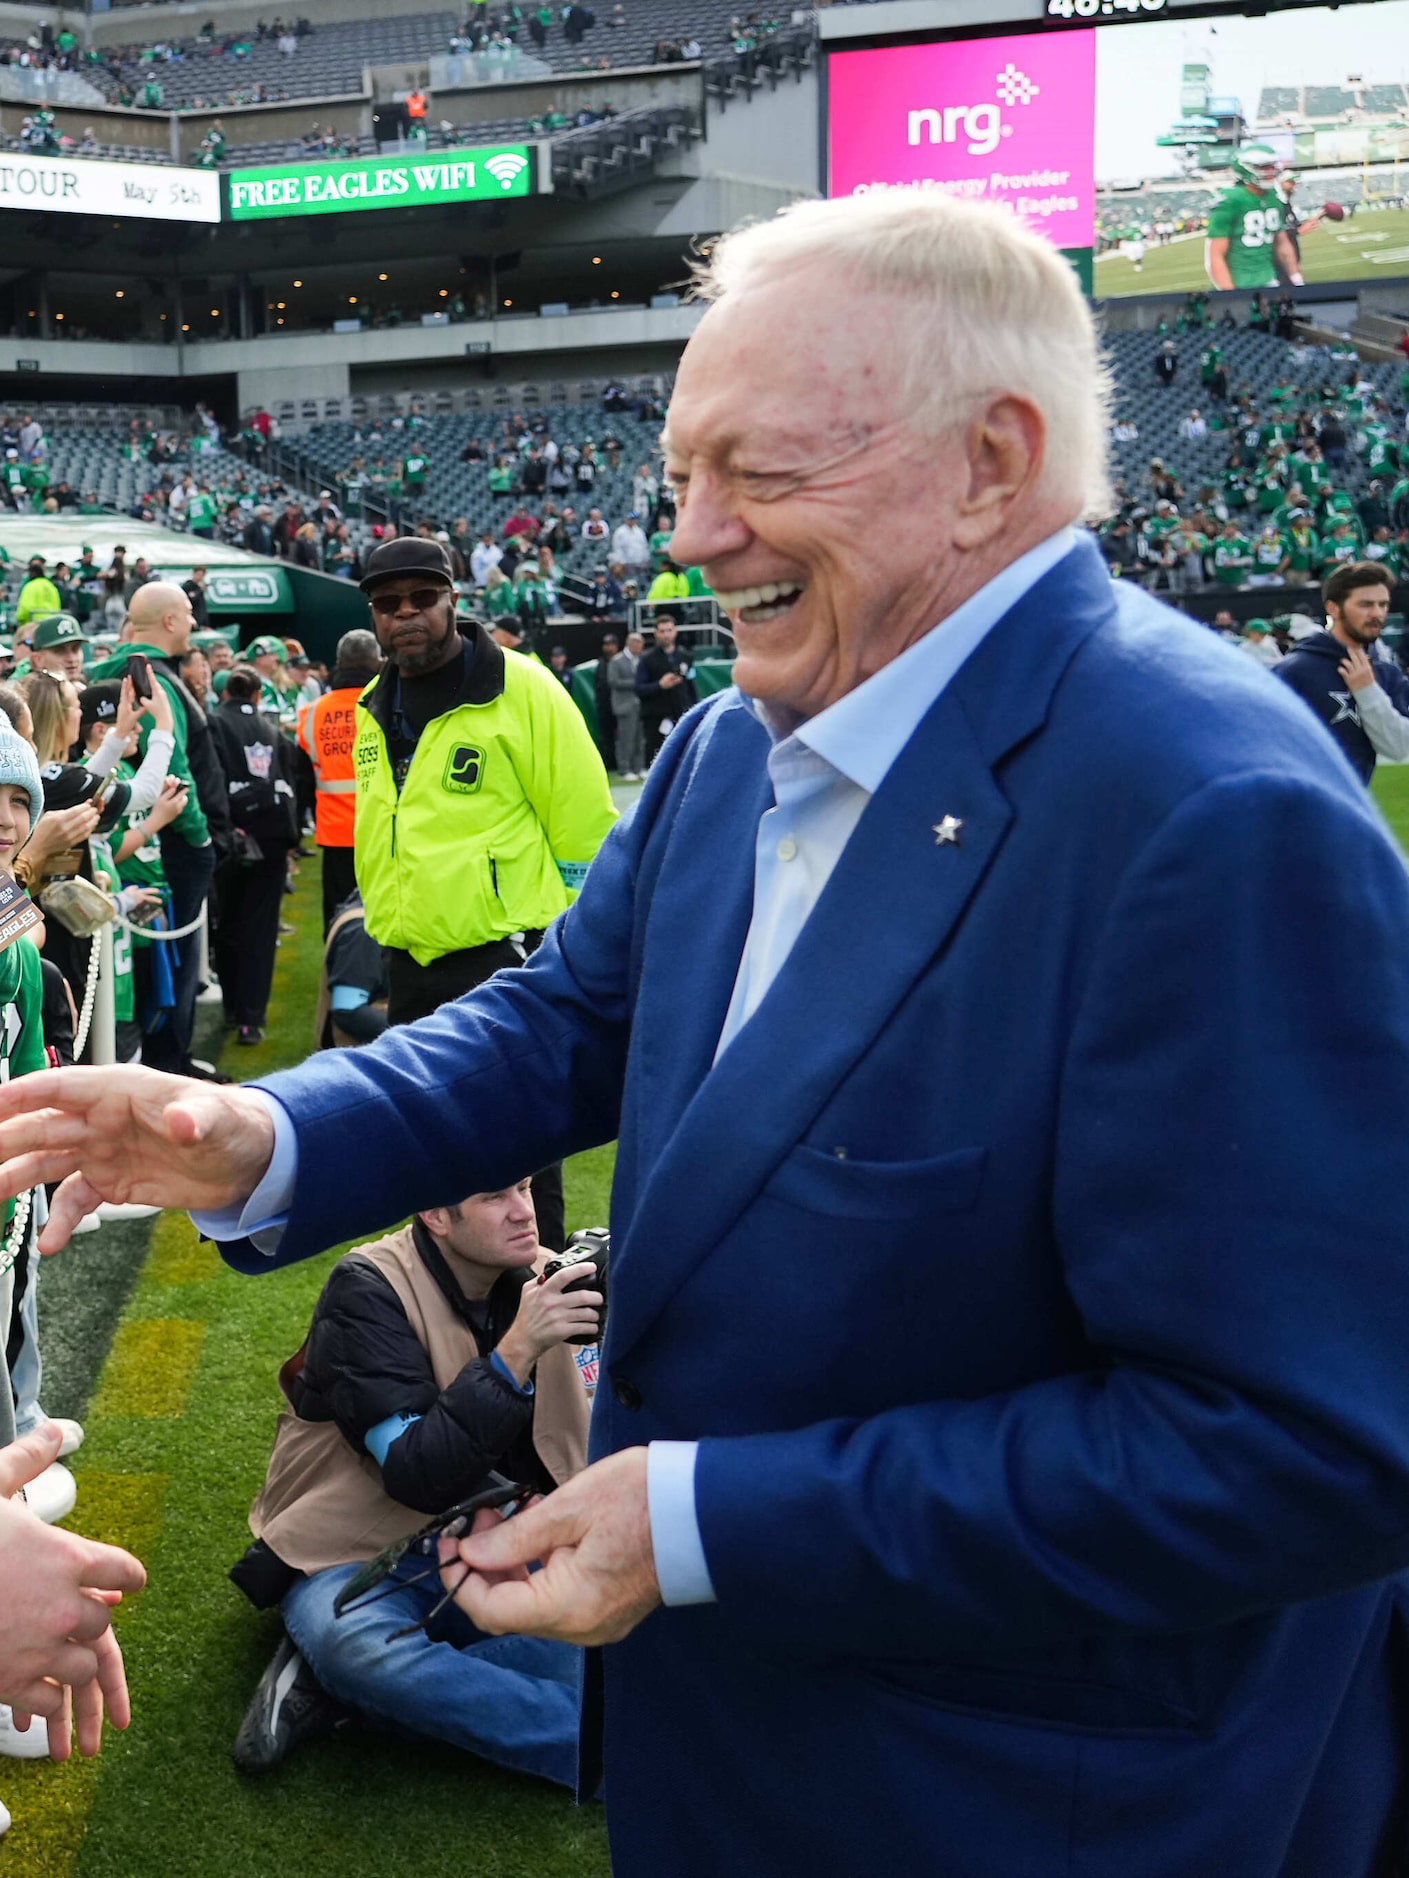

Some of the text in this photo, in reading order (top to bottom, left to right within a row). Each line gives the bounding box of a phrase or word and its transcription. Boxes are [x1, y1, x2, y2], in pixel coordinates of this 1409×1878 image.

[907, 103, 1001, 155] nrg
[231, 161, 477, 209] FREE EAGLES WIFI
[990, 169, 1071, 190] Provider
[123, 180, 202, 205] May 5th
[1016, 195, 1079, 216] Eagles
[324, 710, 355, 724] APE
[320, 725, 357, 741] SECURI
[359, 731, 378, 745] EVEN
[324, 741, 353, 756] GRO
